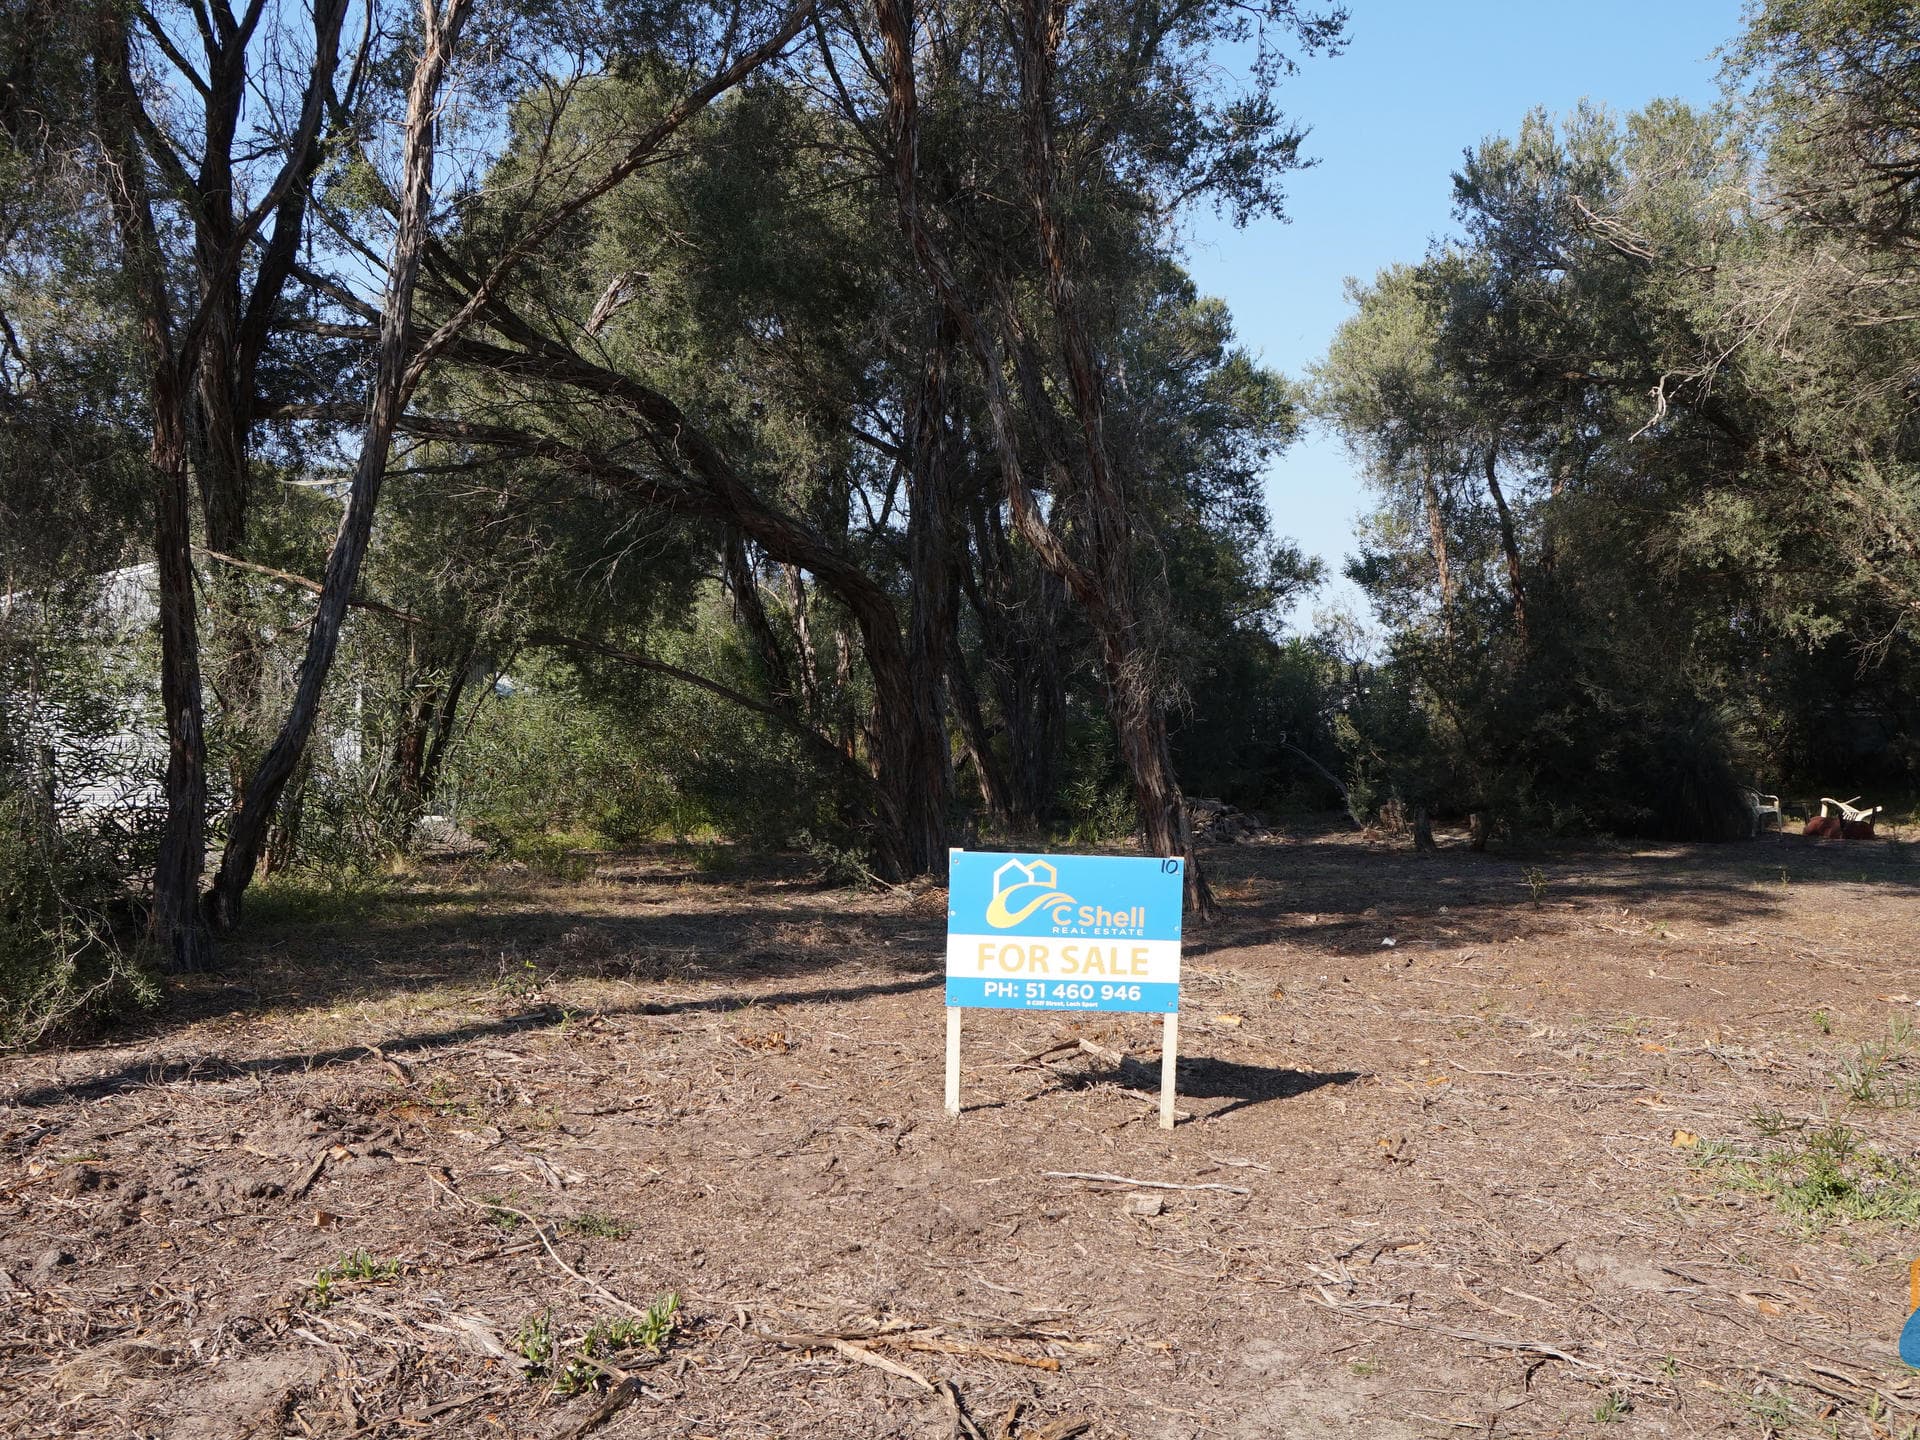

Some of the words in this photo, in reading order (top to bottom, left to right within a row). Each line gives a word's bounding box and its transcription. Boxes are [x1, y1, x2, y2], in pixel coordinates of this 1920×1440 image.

[1161, 859, 1178, 874] 10
[1052, 905, 1072, 926] C
[1078, 905, 1145, 928] Shell
[1052, 926, 1087, 935] REAL
[1094, 927, 1144, 936] ESTATE
[977, 943, 1050, 974] FOR
[1060, 945, 1149, 976] SALE
[984, 981, 1019, 998] PH:
[1025, 983, 1046, 998] 51
[1052, 984, 1094, 1000] 460
[1101, 985, 1141, 1001] 946
